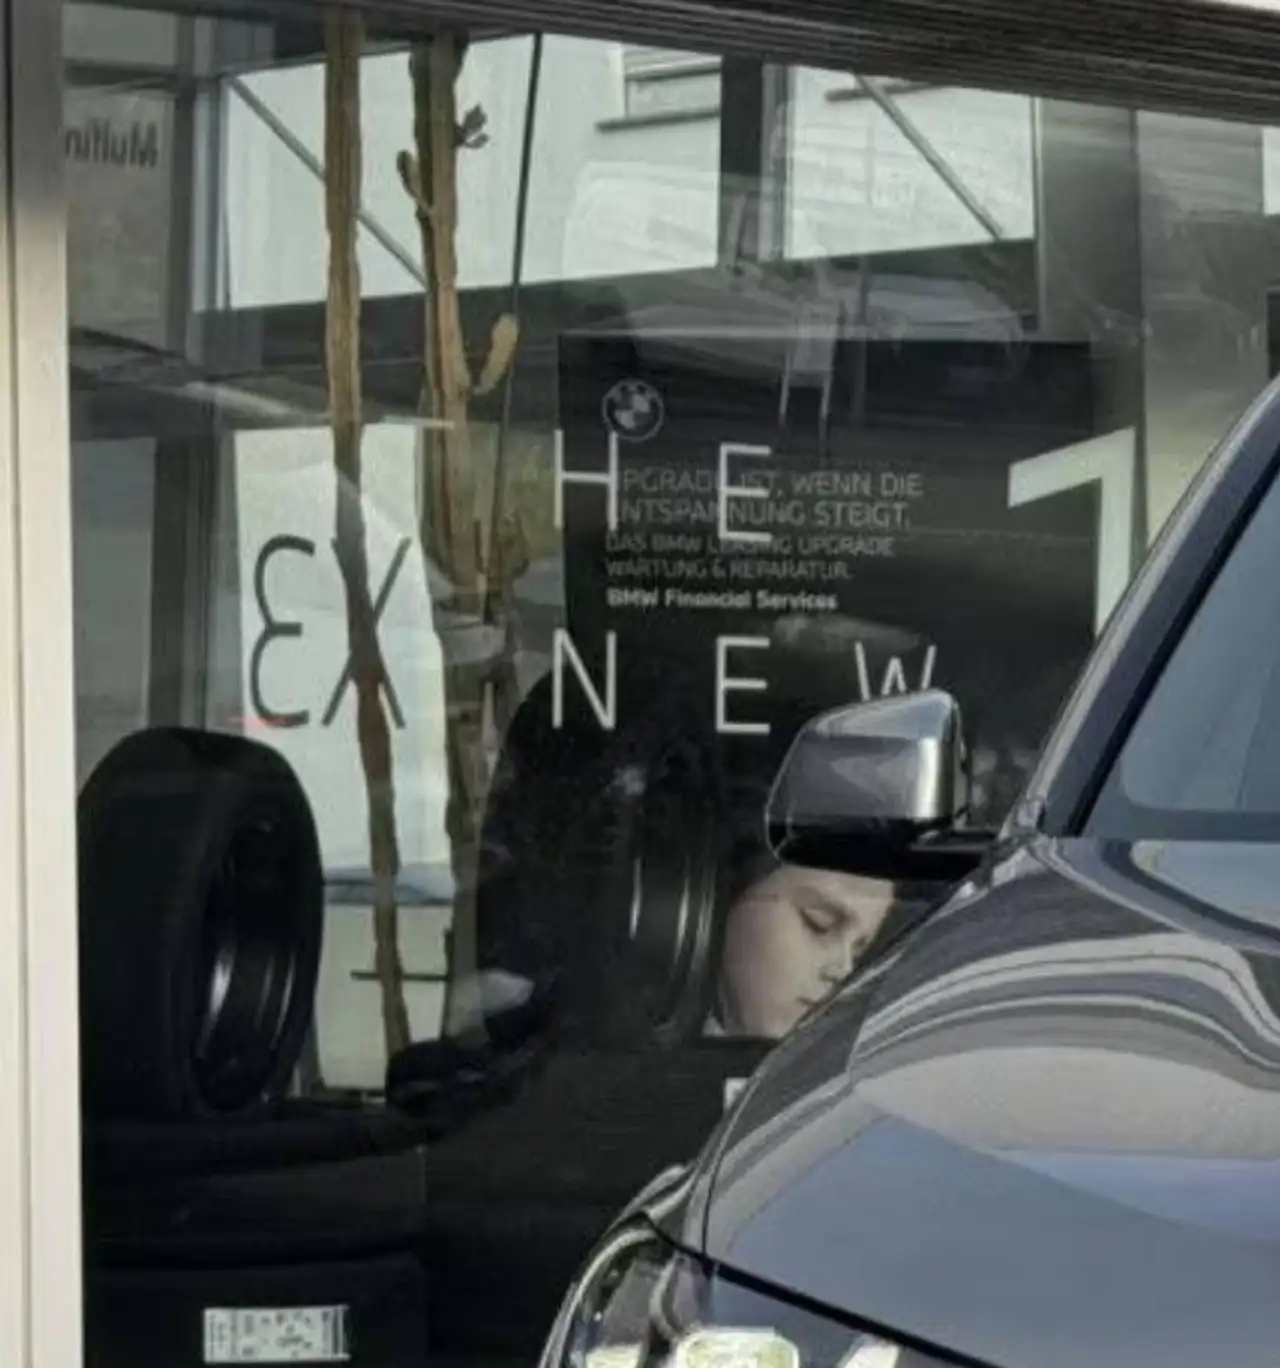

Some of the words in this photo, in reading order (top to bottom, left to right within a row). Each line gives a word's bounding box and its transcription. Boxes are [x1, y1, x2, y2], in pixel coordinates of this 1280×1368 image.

[612, 467, 728, 494] PGRAD
[792, 471, 872, 496] WENN
[880, 471, 925, 497] DIE
[611, 498, 806, 527] NTSPANNUNG
[607, 587, 659, 608] BMW
[665, 588, 751, 609] Financial
[757, 589, 838, 611] Services
